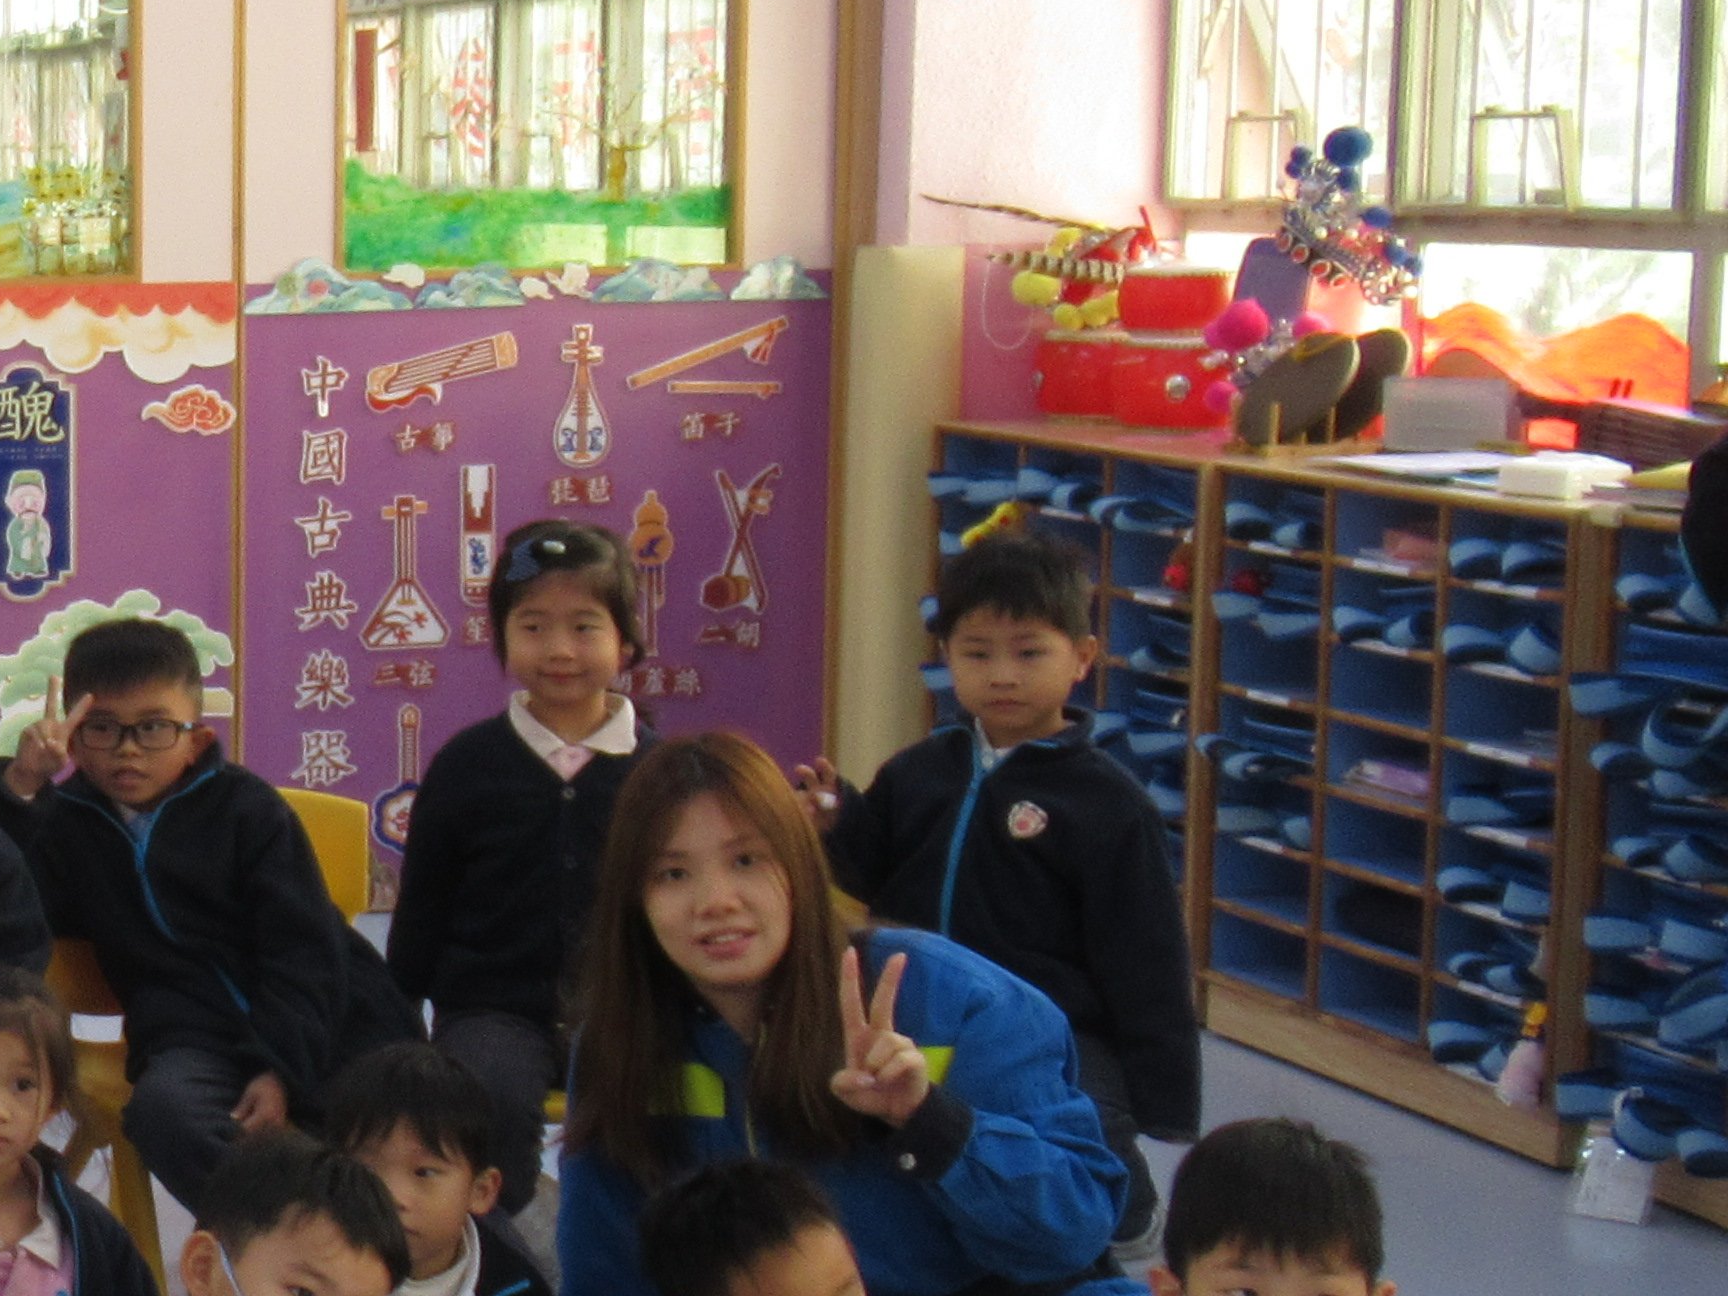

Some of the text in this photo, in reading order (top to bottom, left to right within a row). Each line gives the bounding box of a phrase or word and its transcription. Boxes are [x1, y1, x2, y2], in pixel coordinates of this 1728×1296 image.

[292, 355, 358, 787] 中國古典樂器
